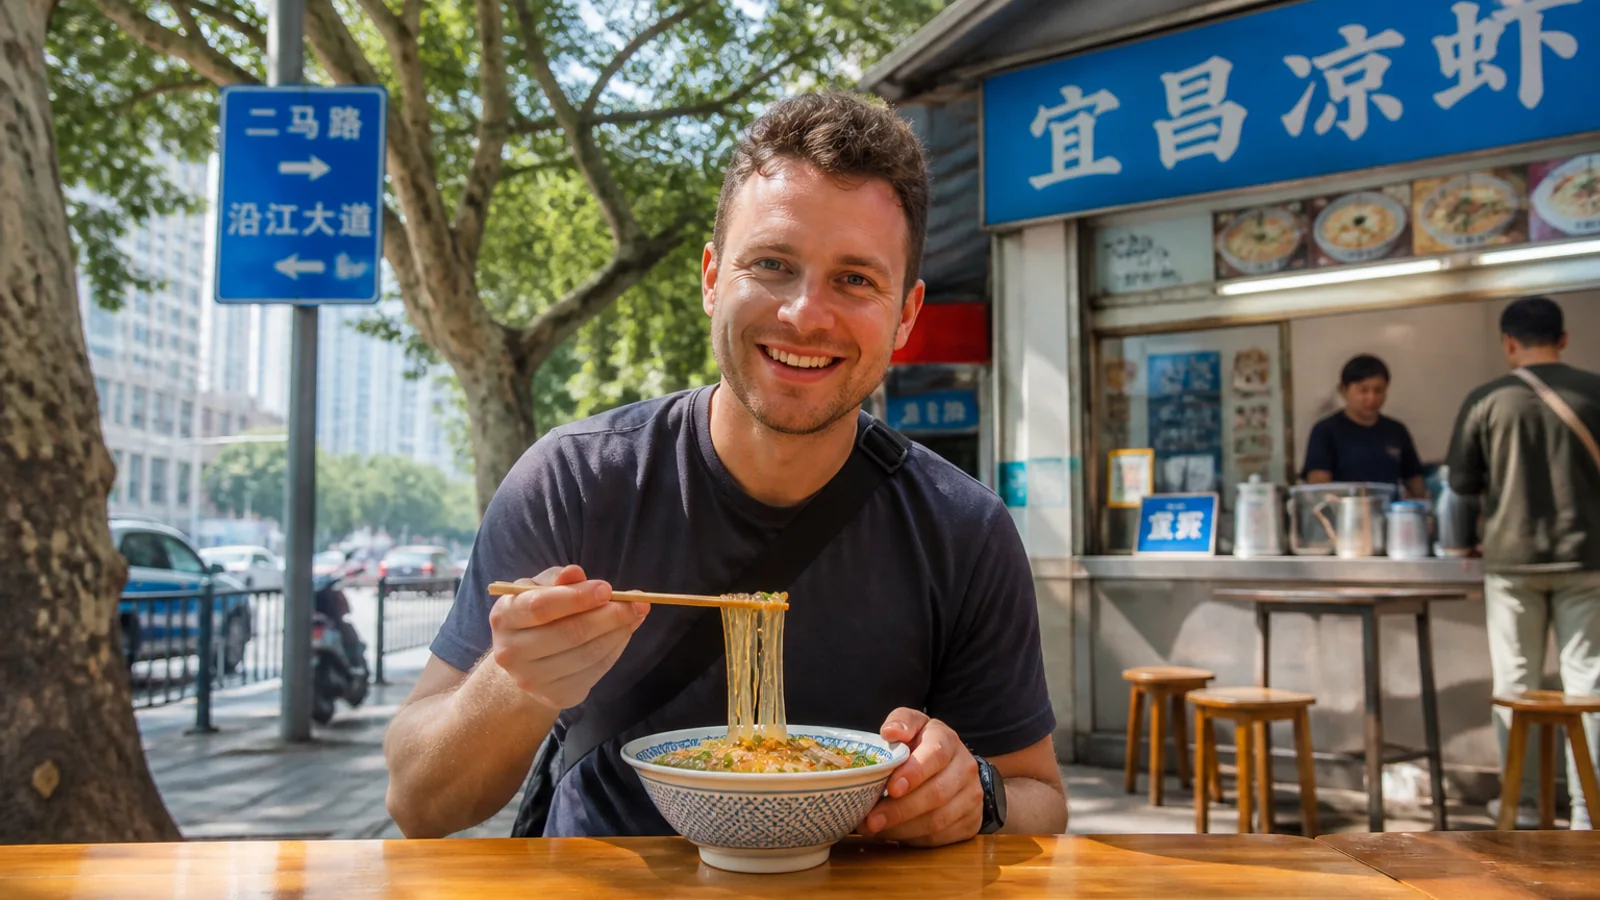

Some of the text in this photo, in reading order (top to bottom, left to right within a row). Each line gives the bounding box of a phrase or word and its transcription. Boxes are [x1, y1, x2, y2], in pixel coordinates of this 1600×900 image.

[1028, 0, 1583, 190] 宜昌凉虾
[245, 105, 362, 140] 二马路
[227, 201, 373, 237] 沿江大道
